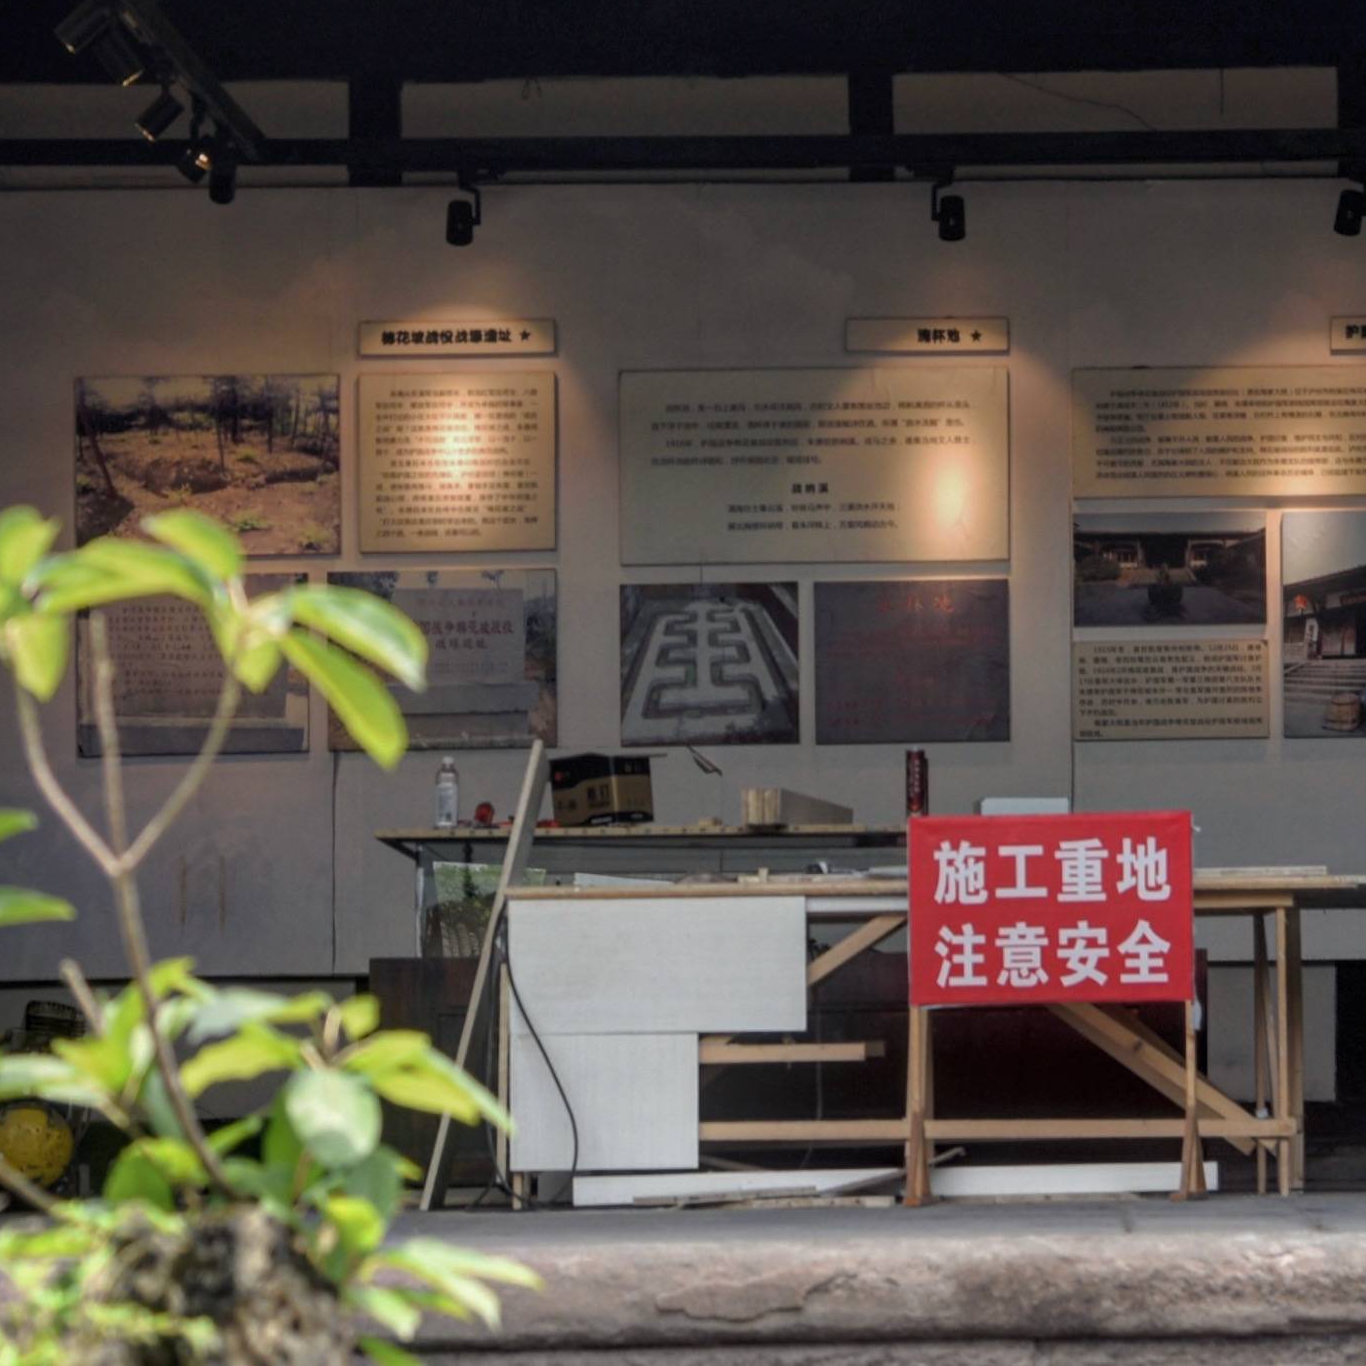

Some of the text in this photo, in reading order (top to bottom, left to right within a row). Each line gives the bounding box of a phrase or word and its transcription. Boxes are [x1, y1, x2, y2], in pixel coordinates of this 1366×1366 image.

[934, 836, 1171, 904] 施工重地
[934, 919, 1171, 987] 注意安全
